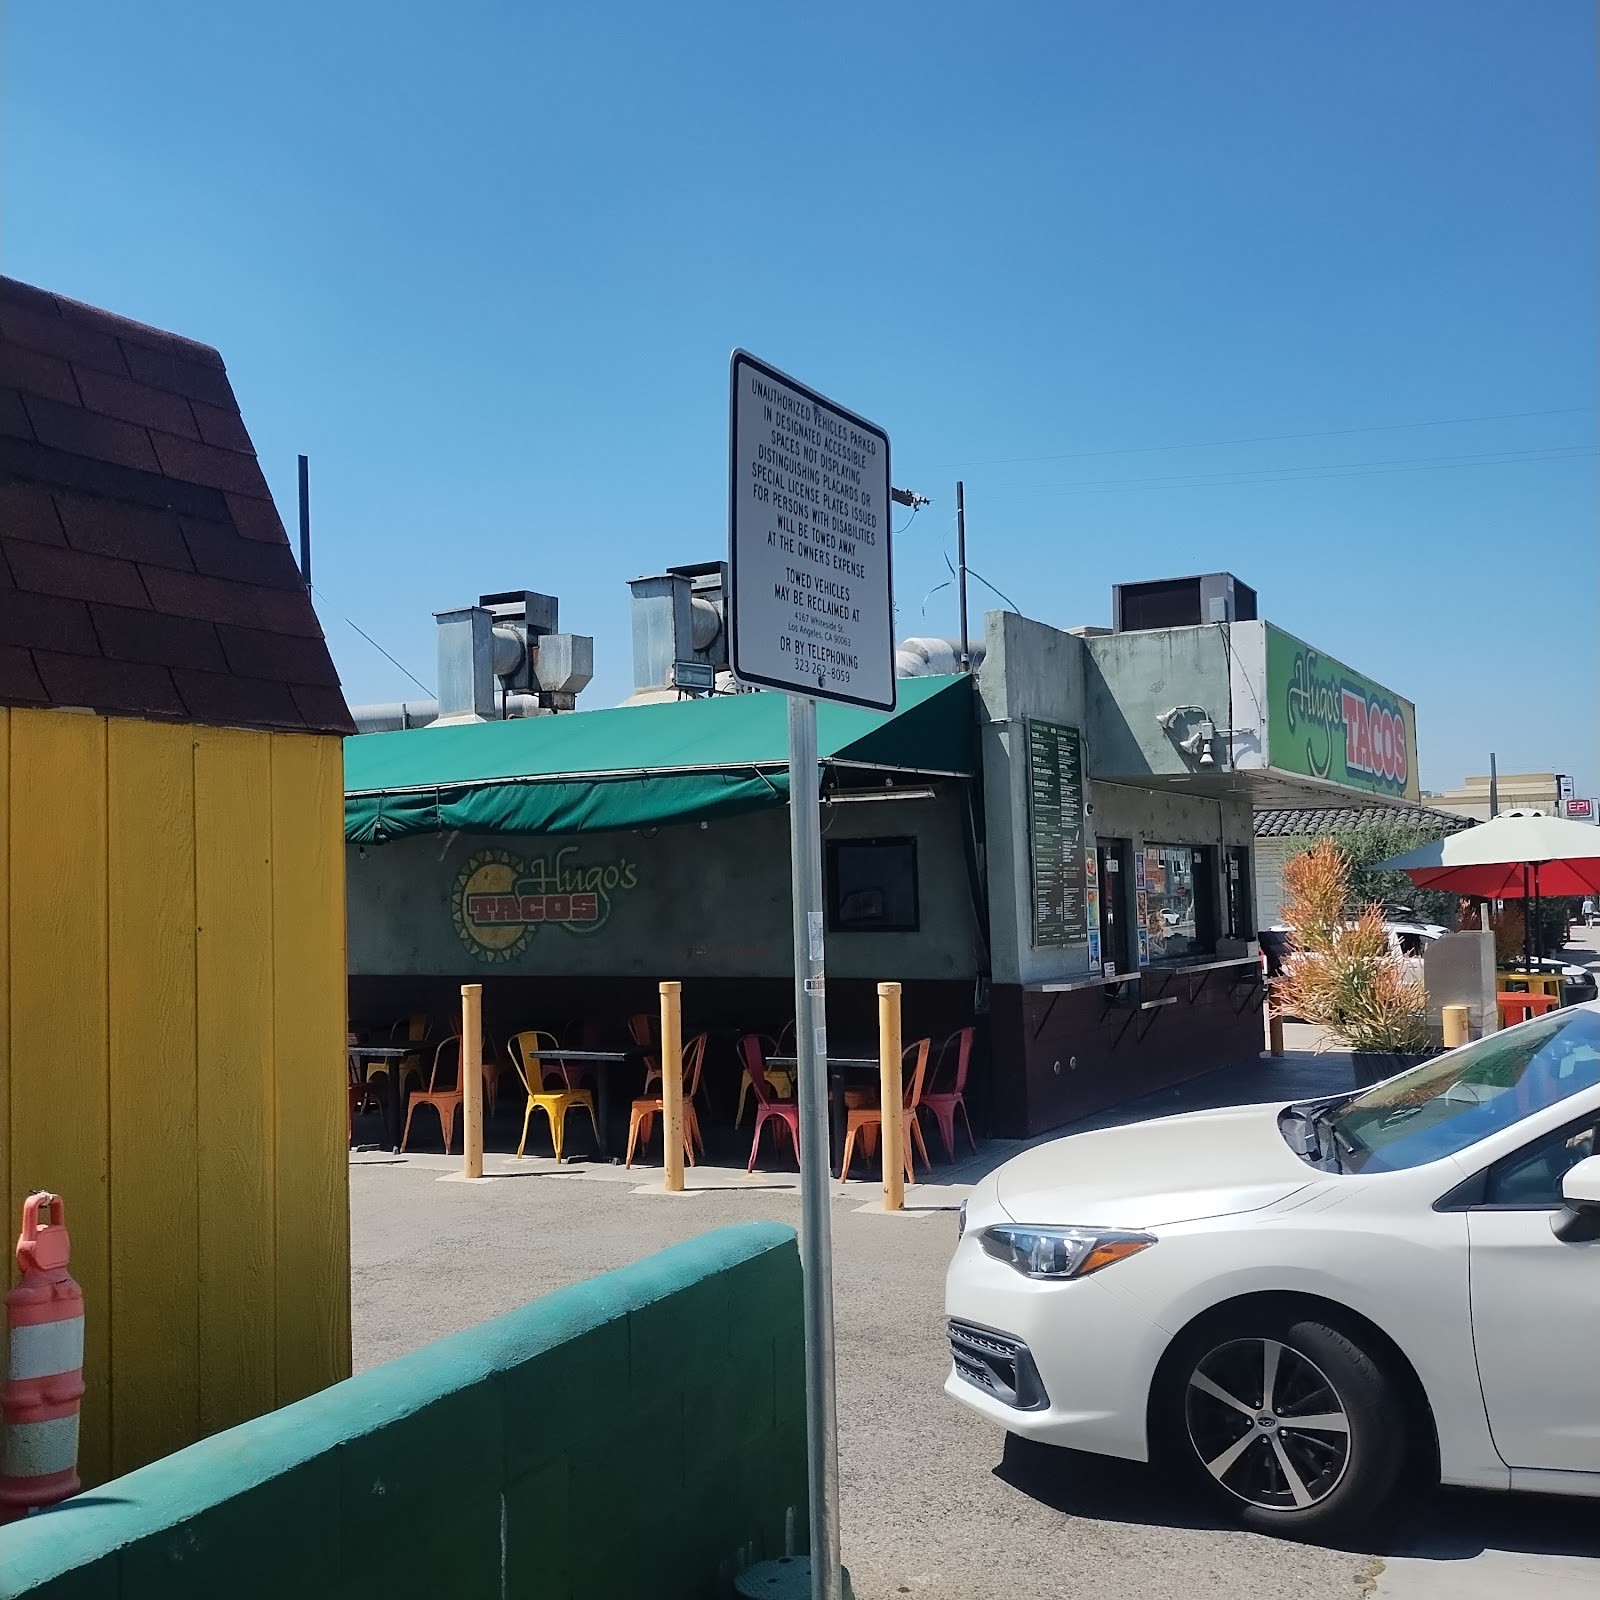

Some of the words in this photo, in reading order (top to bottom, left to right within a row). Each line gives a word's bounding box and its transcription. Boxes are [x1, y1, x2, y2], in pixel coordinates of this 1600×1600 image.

[752, 378, 810, 421] UNAUTHORIZED
[813, 412, 847, 441] VEHICLES
[850, 431, 876, 455] PARKED
[764, 405, 772, 422] IN
[776, 411, 821, 446] DESIGNATED
[824, 436, 866, 469] ACCESSIBLE
[758, 444, 819, 485] DISTINGUISHING
[823, 474, 858, 502] PLACARDS
[862, 491, 871, 507] OR
[771, 430, 800, 456] SPACES
[803, 445, 817, 463] NOT
[821, 453, 860, 485] DISPLAYING
[752, 462, 785, 489] SPECIAL
[788, 478, 820, 504] LICENSE
[823, 493, 849, 516] PLATES
[852, 506, 876, 528] ISSUED
[753, 483, 769, 503] FOR
[773, 491, 809, 519] PERSONS
[812, 508, 829, 527] WITH
[832, 516, 876, 546] DISABILITIES
[767, 531, 776, 547] AT
[780, 535, 794, 553] THE
[798, 542, 830, 566] OWNER'S
[833, 555, 865, 579] EXPENSE
[777, 514, 795, 534] WILL
[799, 522, 808, 539] BE
[812, 527, 836, 549] TOWED
[839, 539, 856, 557] AWAY
[774, 584, 790, 601] MAY
[794, 590, 803, 606] BE
[808, 594, 849, 620] RECLAIMED
[852, 608, 860, 623] AT
[786, 567, 811, 589] TOWED
[815, 577, 850, 601] VEHICLES
[788, 622, 798, 632] Los
[825, 632, 832, 642] CA
[794, 612, 809, 623] 4167
[780, 636, 791, 652] OR
[795, 640, 805, 655] BY
[808, 643, 858, 669] TELEPHONING
[794, 657, 809, 673] 323
[812, 662, 850, 683] 262-8059
[1289, 651, 1340, 779] Hugo's
[1341, 688, 1407, 785] TACOS
[469, 893, 598, 923] TACOS
[515, 846, 637, 933] Hugo's
